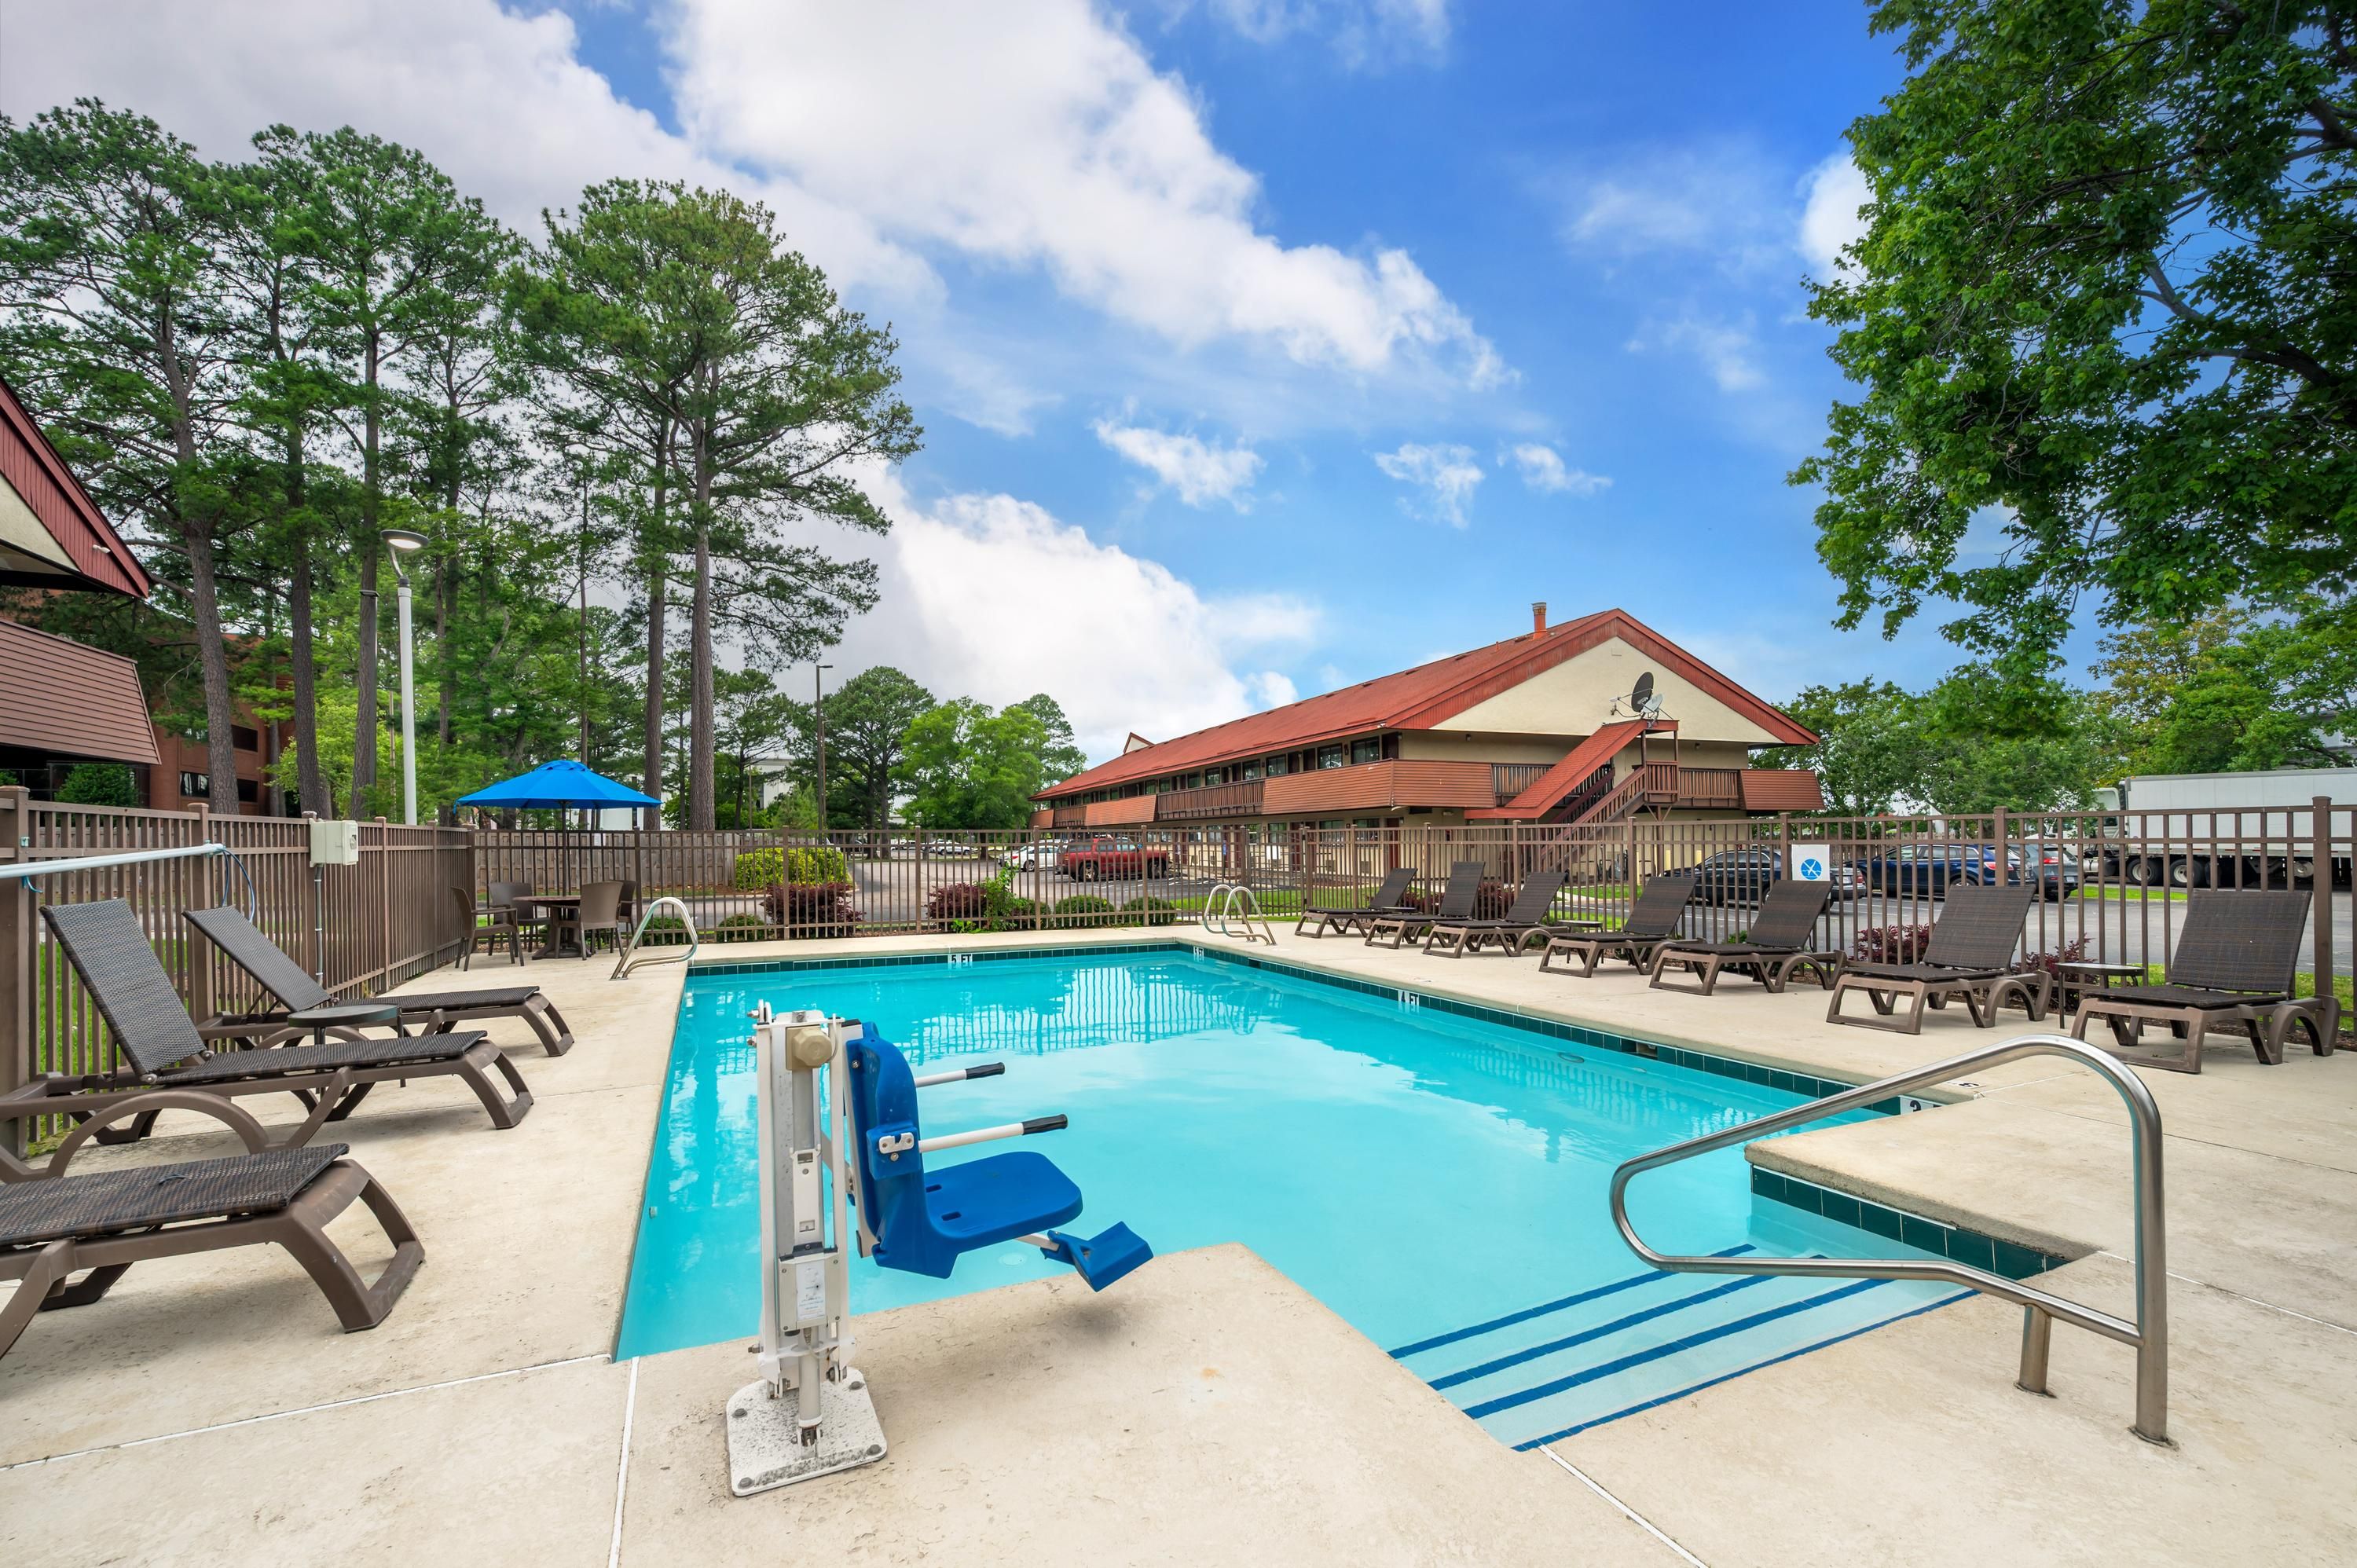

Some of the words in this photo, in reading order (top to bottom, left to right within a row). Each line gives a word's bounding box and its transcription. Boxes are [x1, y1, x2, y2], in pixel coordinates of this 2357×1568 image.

[951, 954, 957, 963] 5
[961, 954, 972, 962] FT
[1409, 992, 1419, 1006] FT
